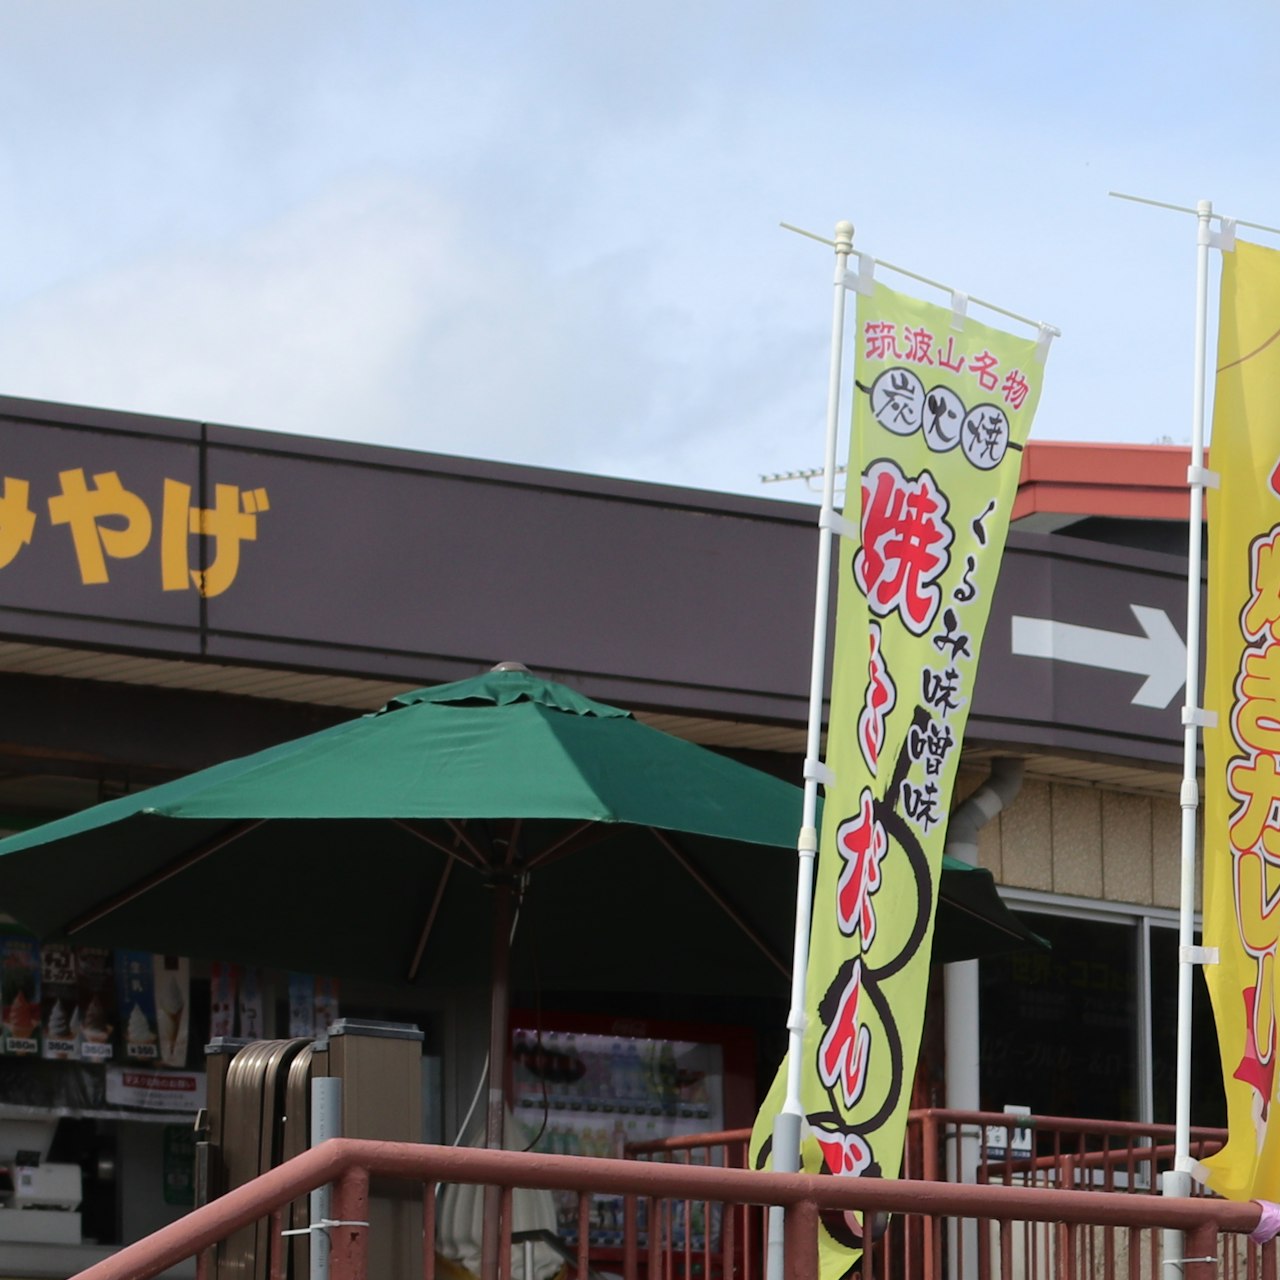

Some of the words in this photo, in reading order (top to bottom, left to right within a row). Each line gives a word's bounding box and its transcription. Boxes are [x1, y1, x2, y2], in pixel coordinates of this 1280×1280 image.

[864, 321, 1031, 411] 筑波山名物
[875, 371, 1004, 464] 炭火焼
[900, 499, 997, 834] くるみ味噌味
